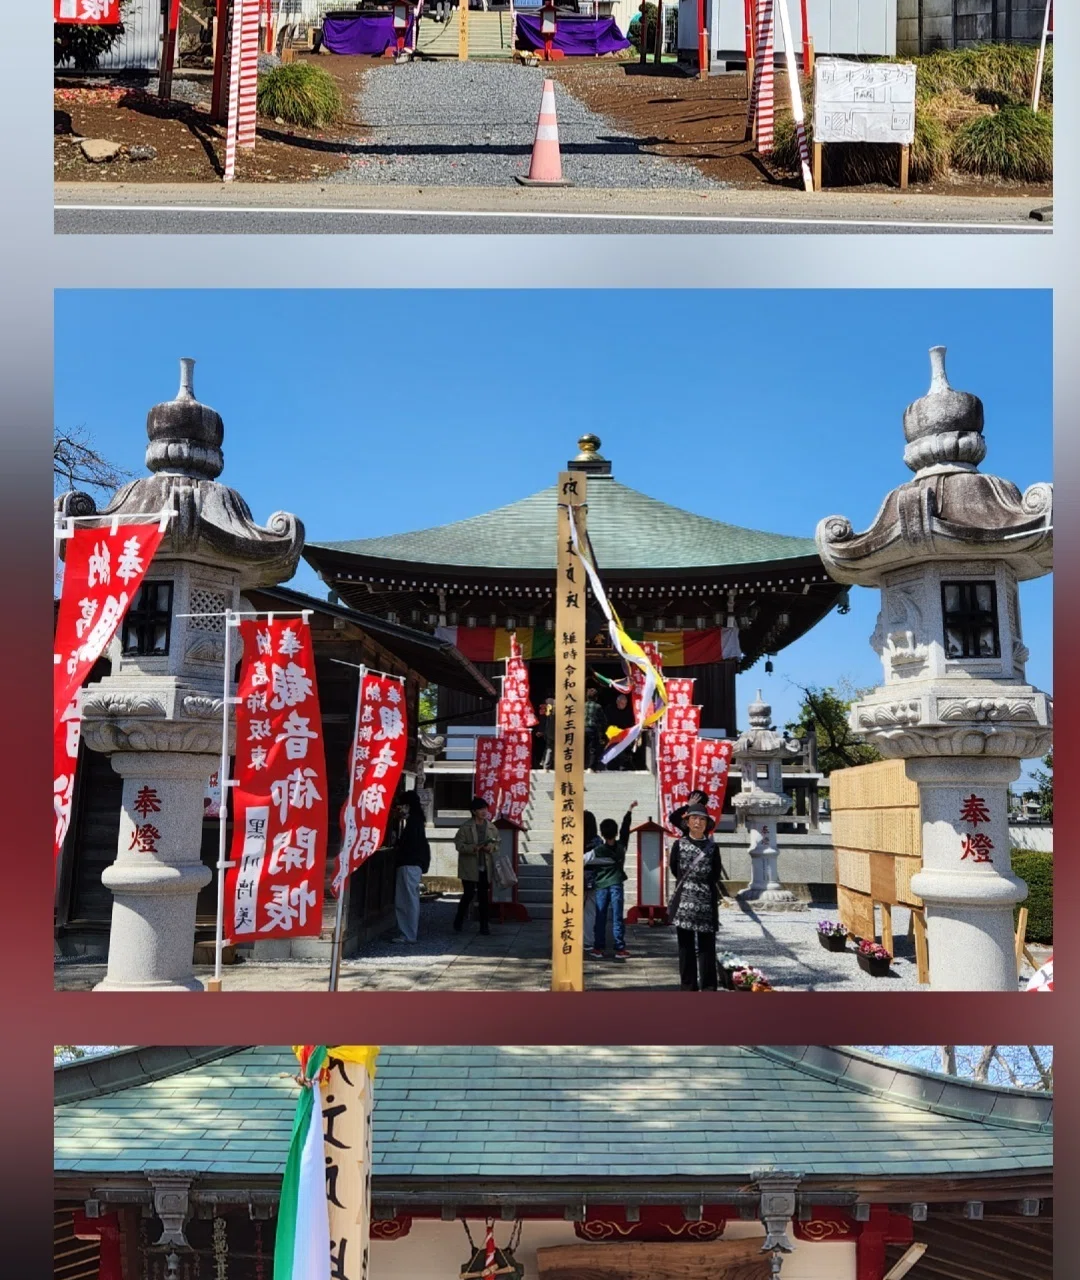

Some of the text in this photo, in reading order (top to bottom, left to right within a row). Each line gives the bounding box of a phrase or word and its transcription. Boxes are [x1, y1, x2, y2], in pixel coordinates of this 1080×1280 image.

[561, 631, 578, 773] 維時令和八年三月吉日
[128, 785, 161, 853] 奉燈
[959, 792, 995, 864] 奉燈
